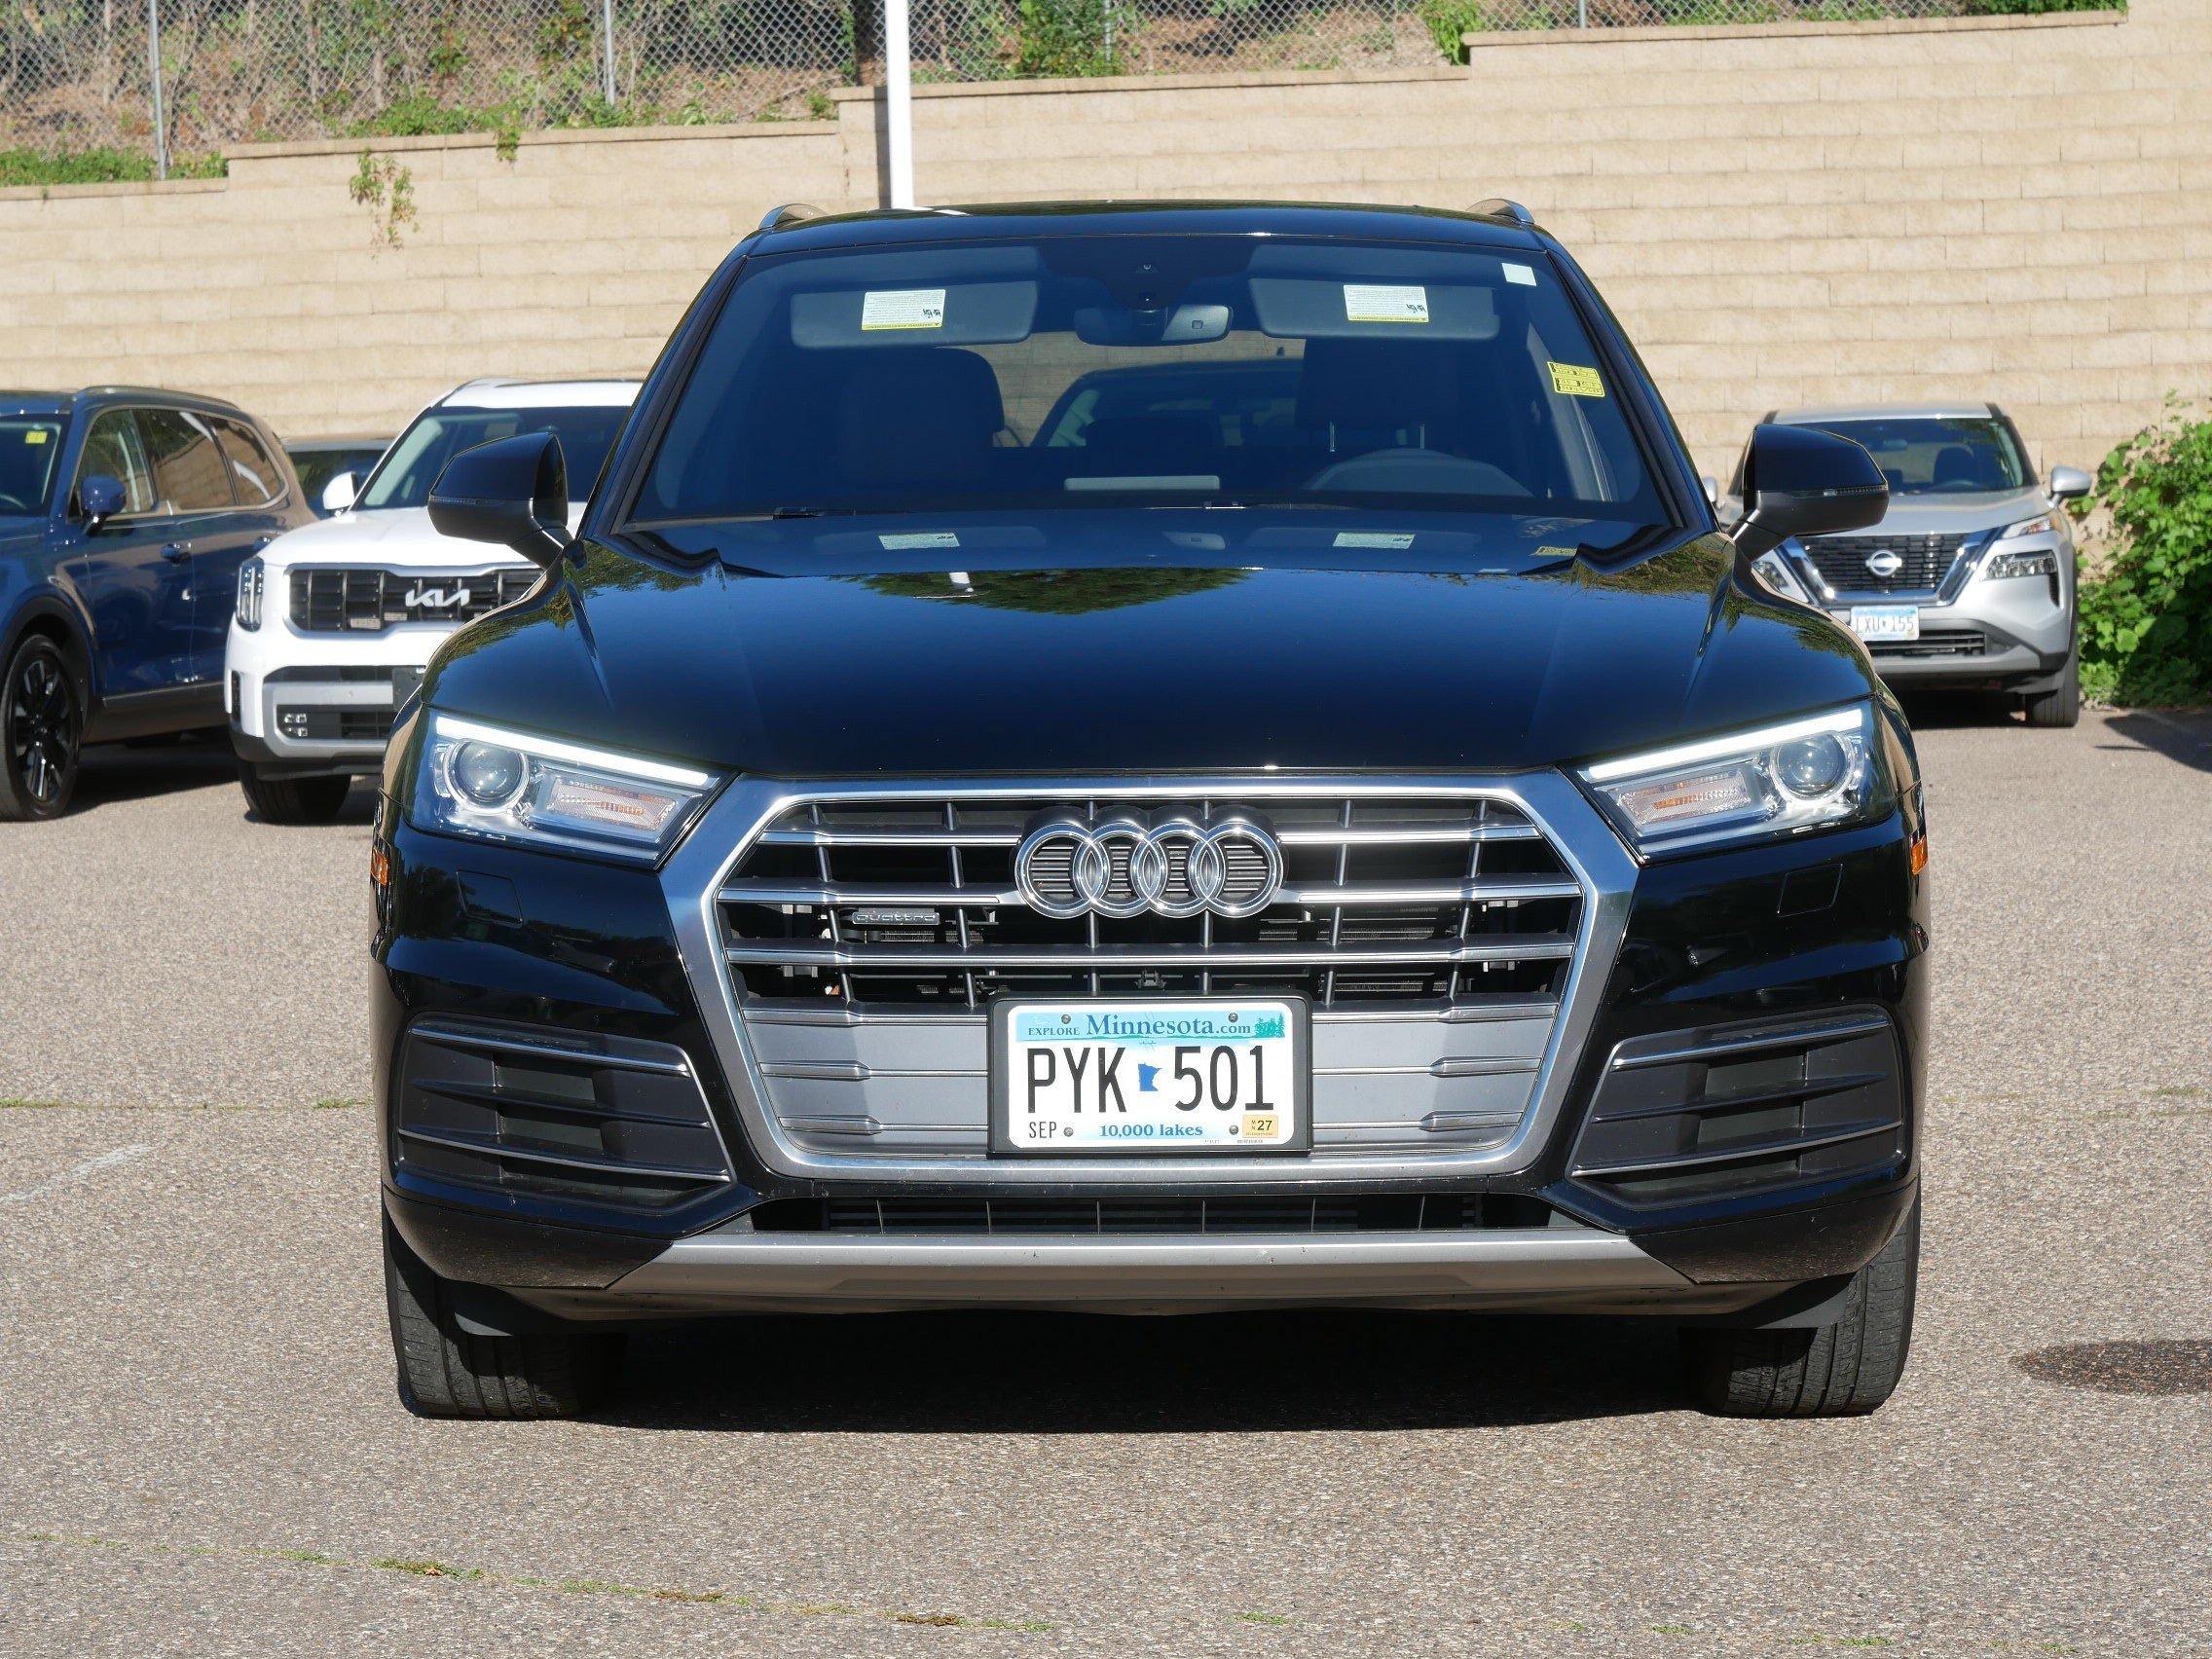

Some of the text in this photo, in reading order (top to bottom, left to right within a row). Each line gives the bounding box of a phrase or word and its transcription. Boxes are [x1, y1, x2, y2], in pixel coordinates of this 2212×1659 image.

[405, 588, 470, 608] KIA
[1891, 615, 1914, 632] 155
[856, 912, 936, 922] quattro
[1027, 1014, 1251, 1036] EXPLORE Minnesota.com
[1027, 1046, 1273, 1113] PYK 501
[1028, 1121, 1057, 1139] SEP
[1099, 1124, 1202, 1138] 10,000 lakes
[1257, 1120, 1272, 1131] 27
